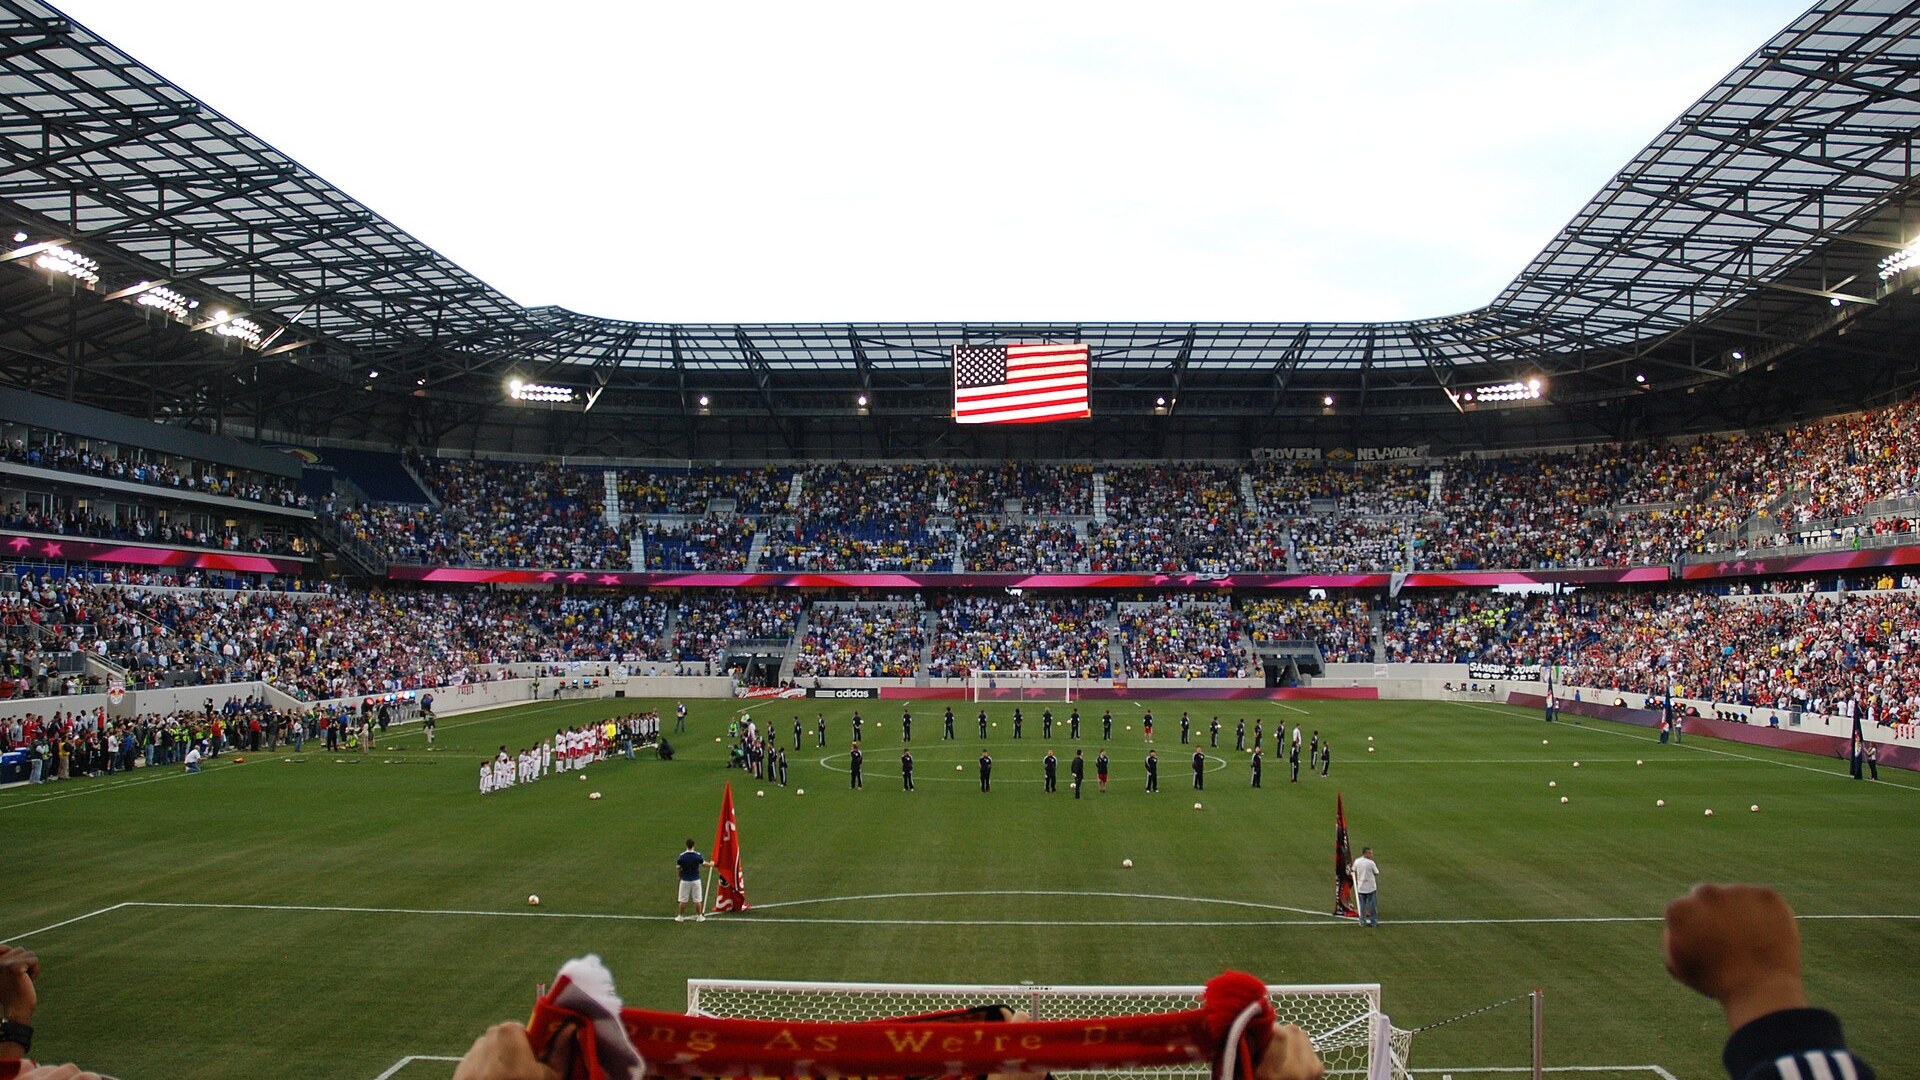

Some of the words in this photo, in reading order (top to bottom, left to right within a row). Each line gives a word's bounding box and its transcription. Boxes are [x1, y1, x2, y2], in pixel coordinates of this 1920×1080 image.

[1264, 447, 1321, 460] JOVEM
[739, 687, 785, 698] Budweiser
[836, 689, 869, 698] adidas
[763, 1029, 838, 1051] As
[884, 1029, 1042, 1053] We're
